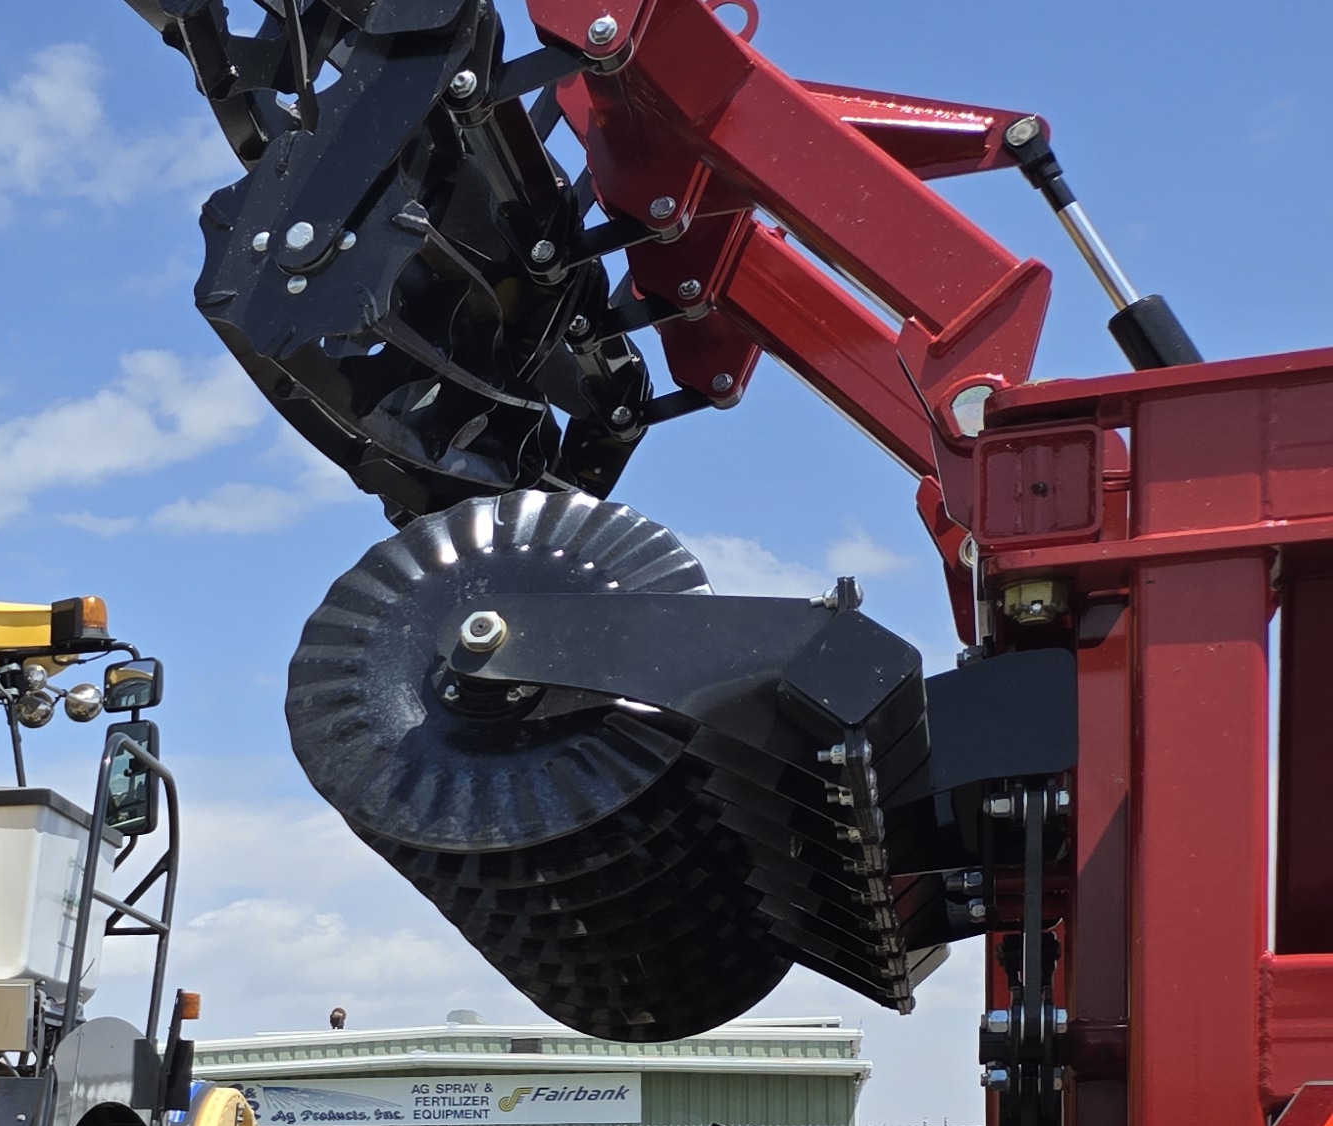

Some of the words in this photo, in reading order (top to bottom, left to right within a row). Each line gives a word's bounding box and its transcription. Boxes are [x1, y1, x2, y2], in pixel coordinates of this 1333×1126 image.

[411, 1085, 430, 1095] AG
[435, 1083, 478, 1094] SPRAY
[484, 1083, 493, 1093] &
[531, 1085, 630, 1102] Fairbank
[414, 1096, 490, 1107] FERTILIZER
[271, 1110, 296, 1125] Ag
[413, 1109, 490, 1120] EQUIPMENT
